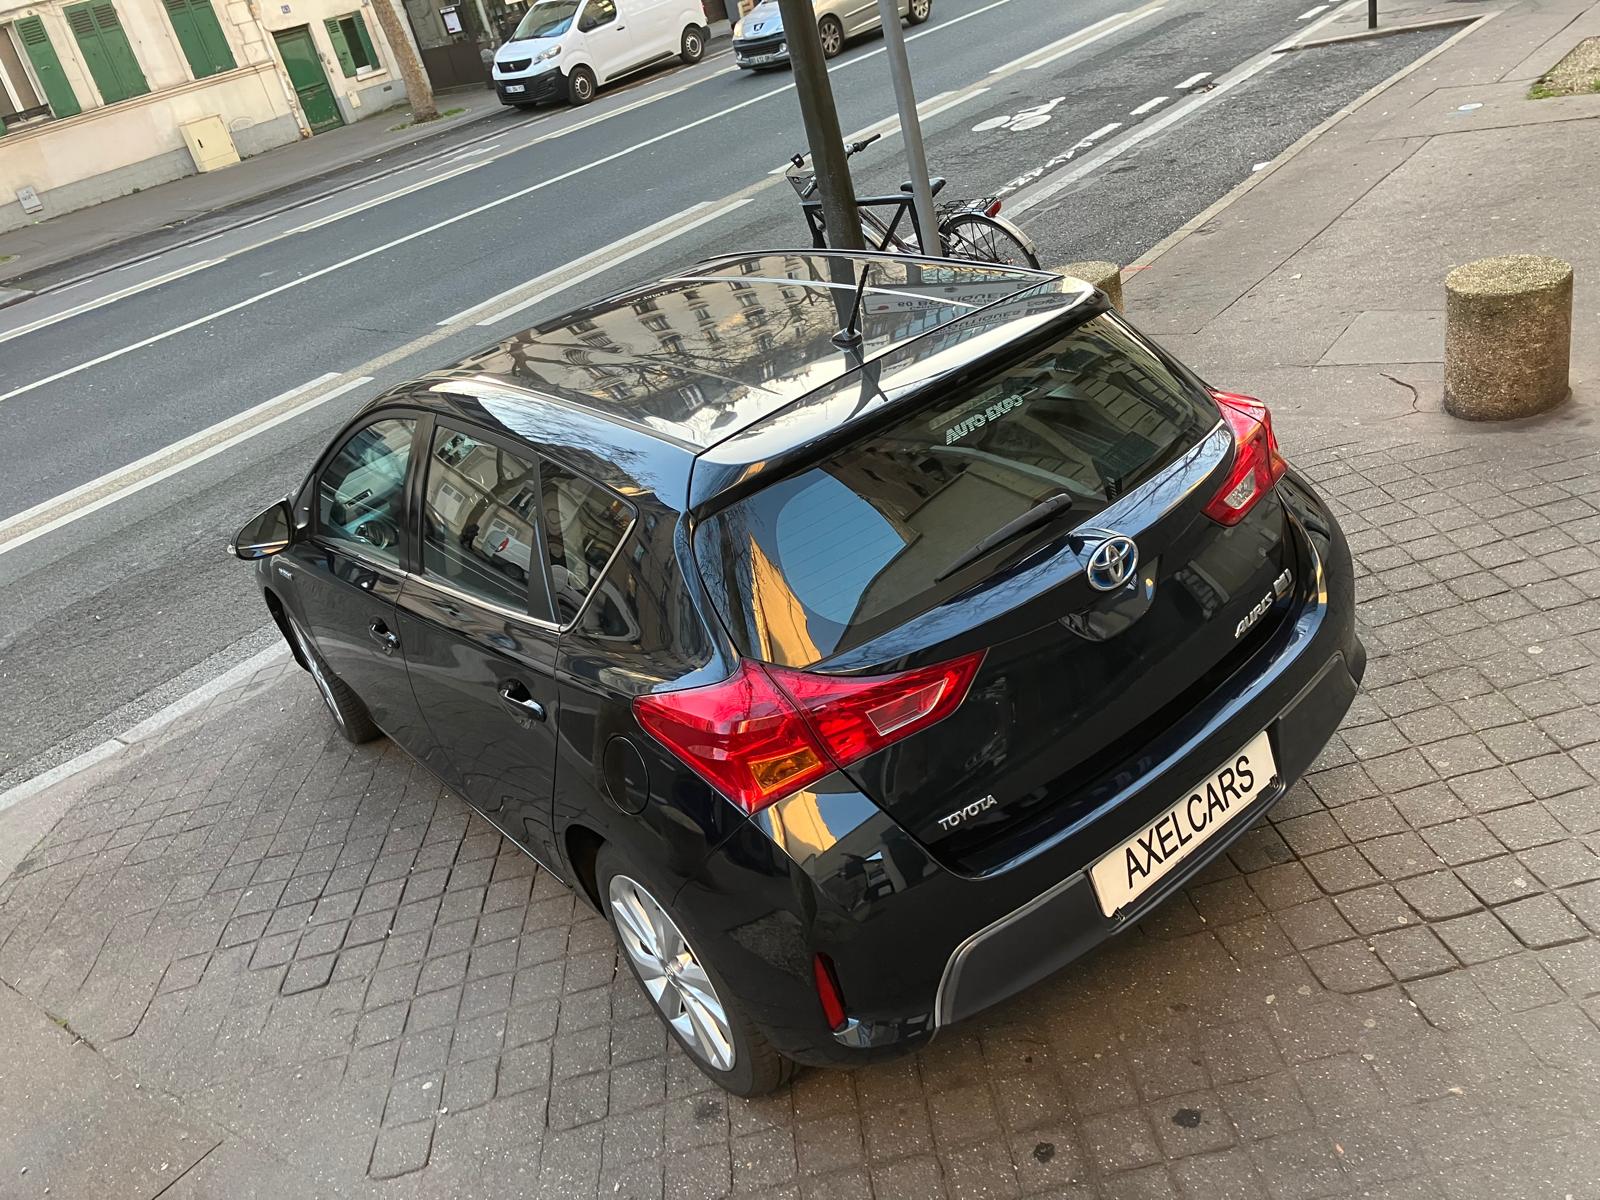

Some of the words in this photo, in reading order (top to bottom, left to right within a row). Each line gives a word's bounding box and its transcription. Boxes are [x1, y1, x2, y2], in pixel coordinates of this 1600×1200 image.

[1234, 591, 1273, 639] AURIS
[937, 794, 998, 831] TOYOTA
[1125, 755, 1255, 890] AXELCARS
